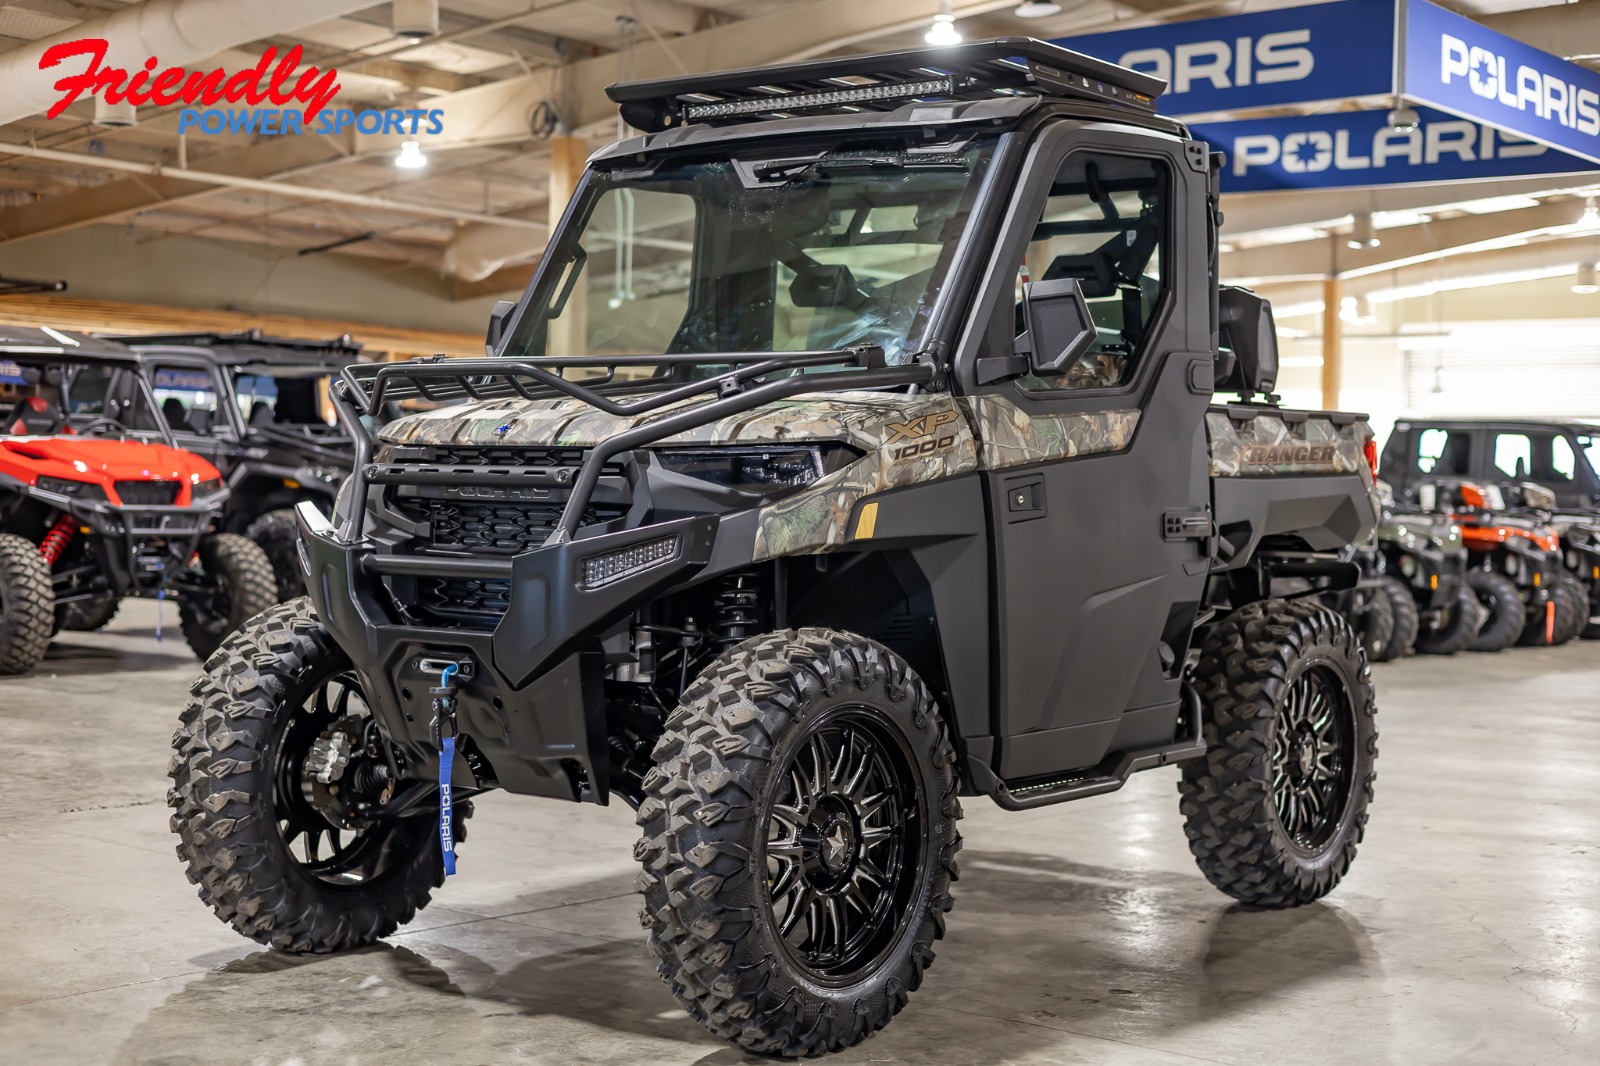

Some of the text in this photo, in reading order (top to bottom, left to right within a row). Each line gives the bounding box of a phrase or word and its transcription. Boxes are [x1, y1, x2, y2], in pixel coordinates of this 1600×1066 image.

[1441, 33, 1600, 137] POLARIS
[883, 410, 959, 444] XP
[894, 436, 955, 461] 1000
[1248, 444, 1336, 465] RANGER
[441, 783, 453, 853] POLARIS
